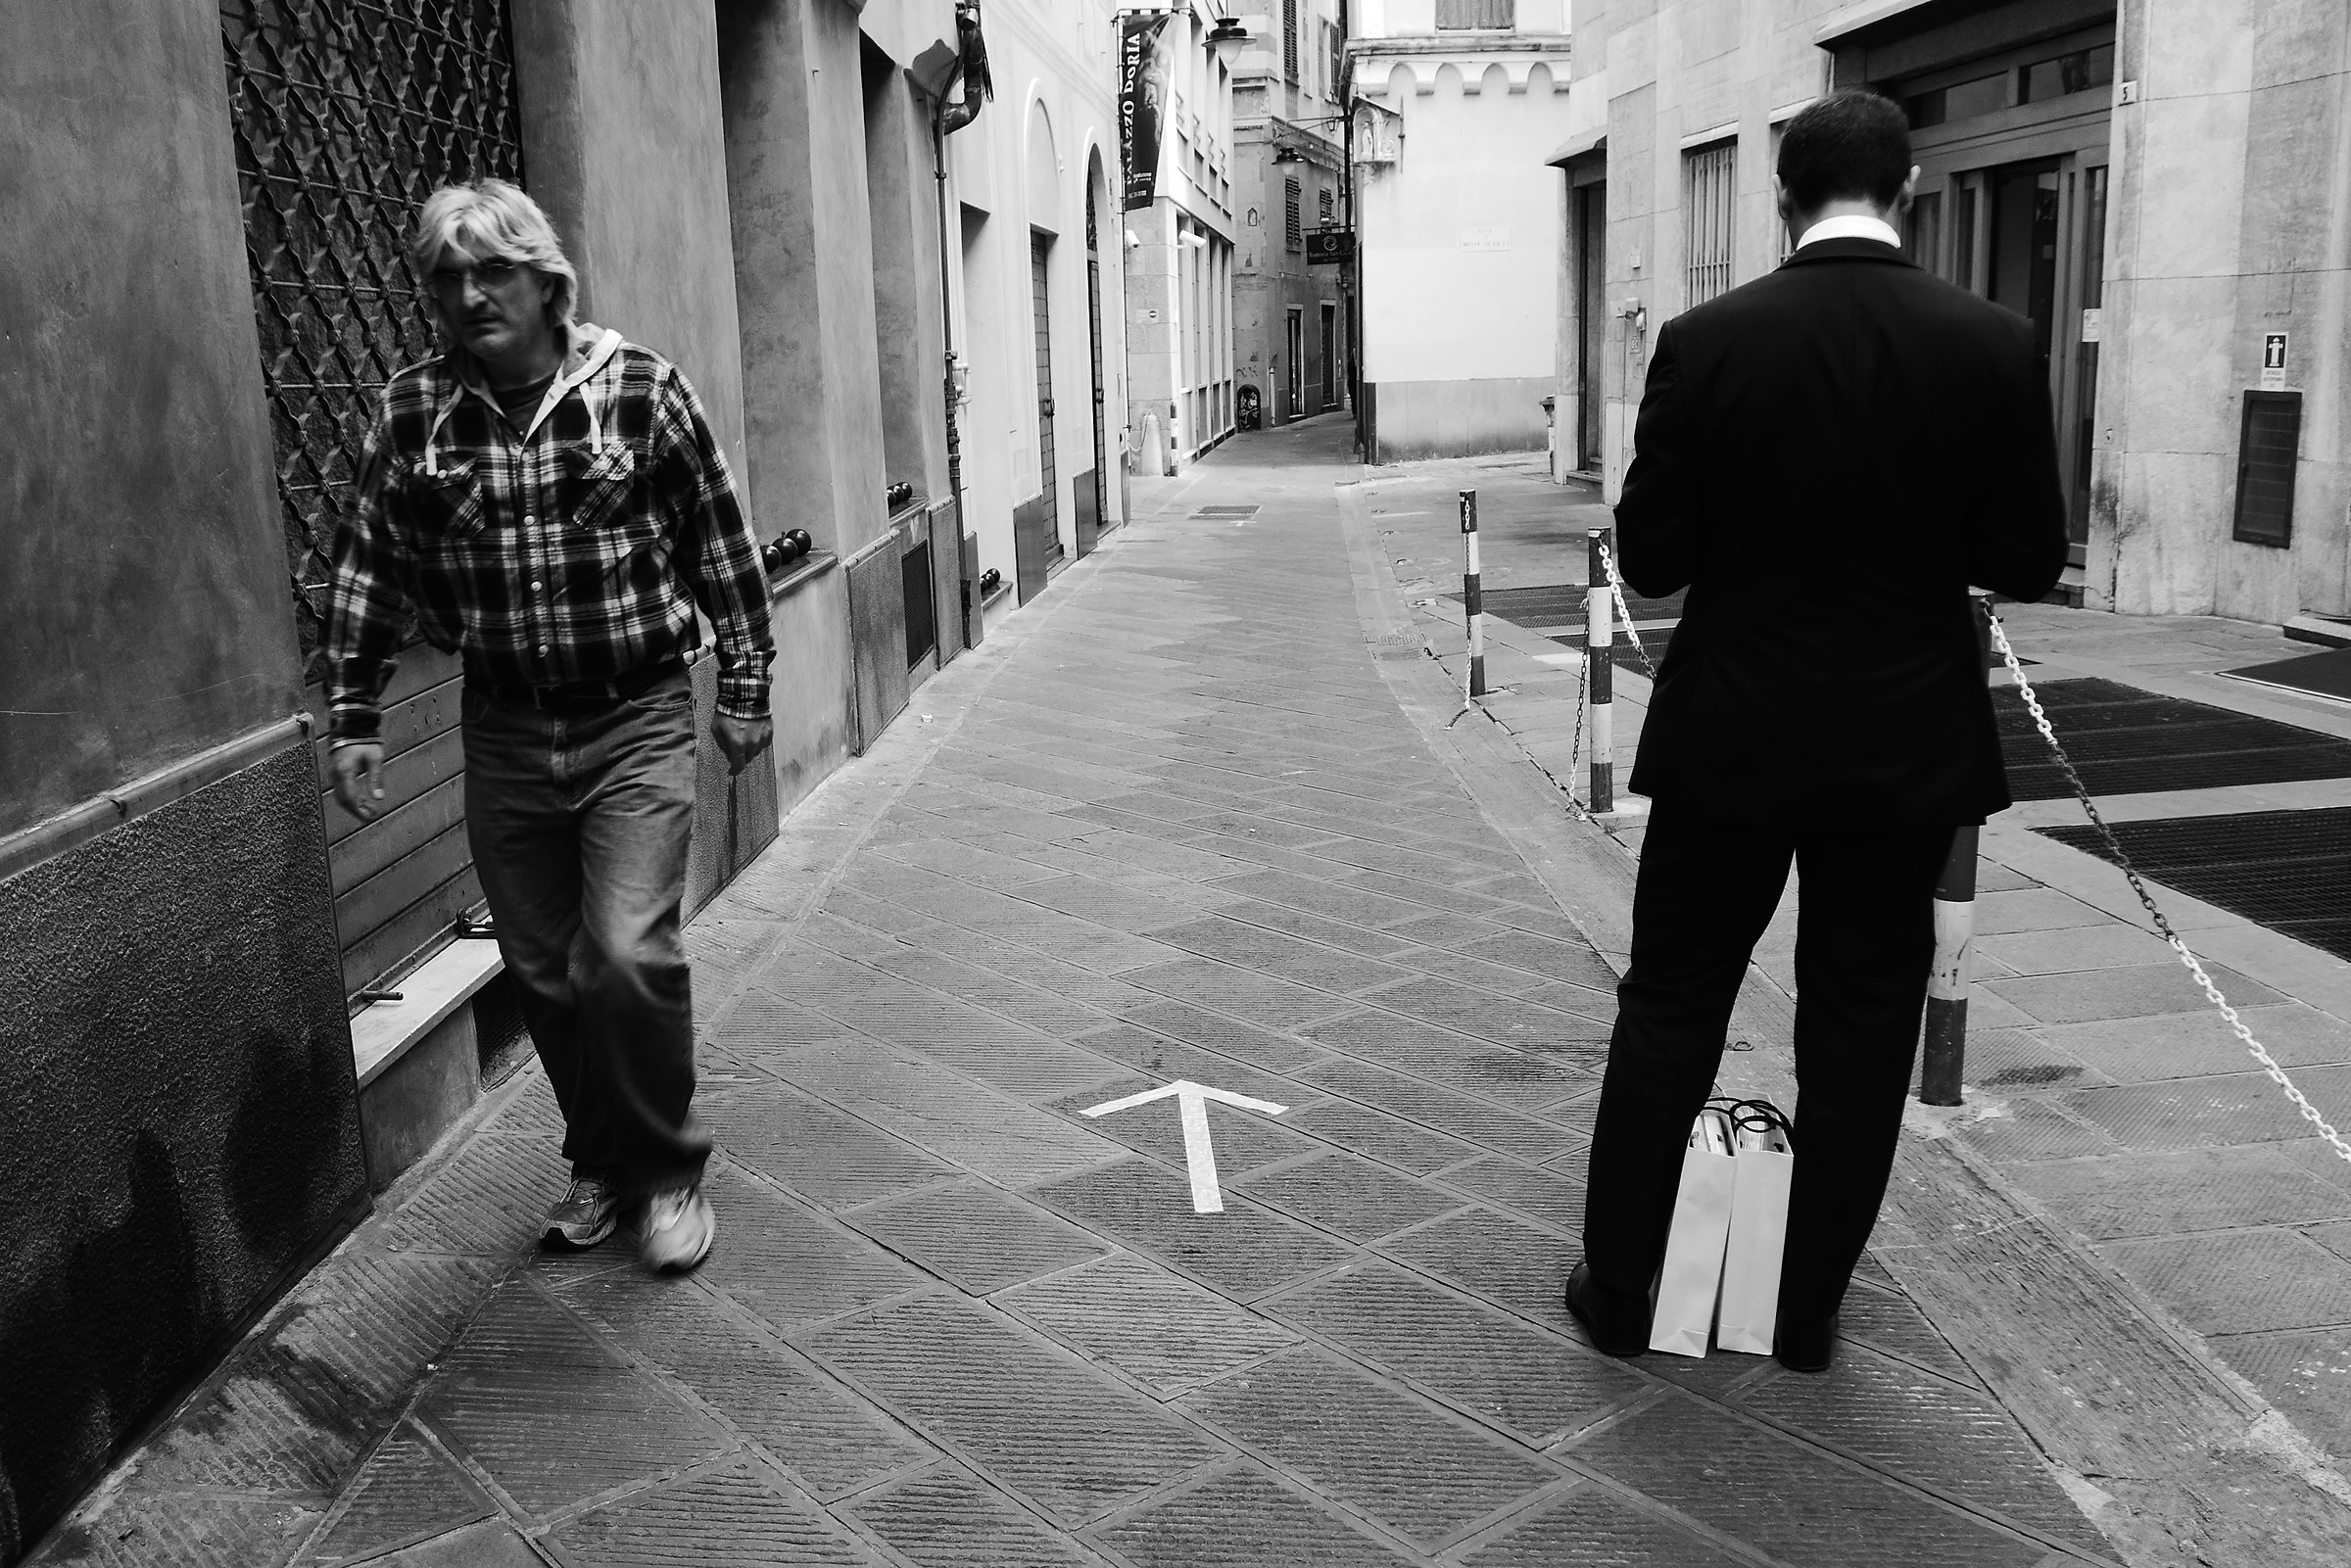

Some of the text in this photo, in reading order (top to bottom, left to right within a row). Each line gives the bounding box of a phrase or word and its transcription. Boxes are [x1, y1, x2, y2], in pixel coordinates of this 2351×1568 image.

[1122, 32, 1140, 185] PALAZZO DORIA
[2123, 86, 2128, 101] 5
